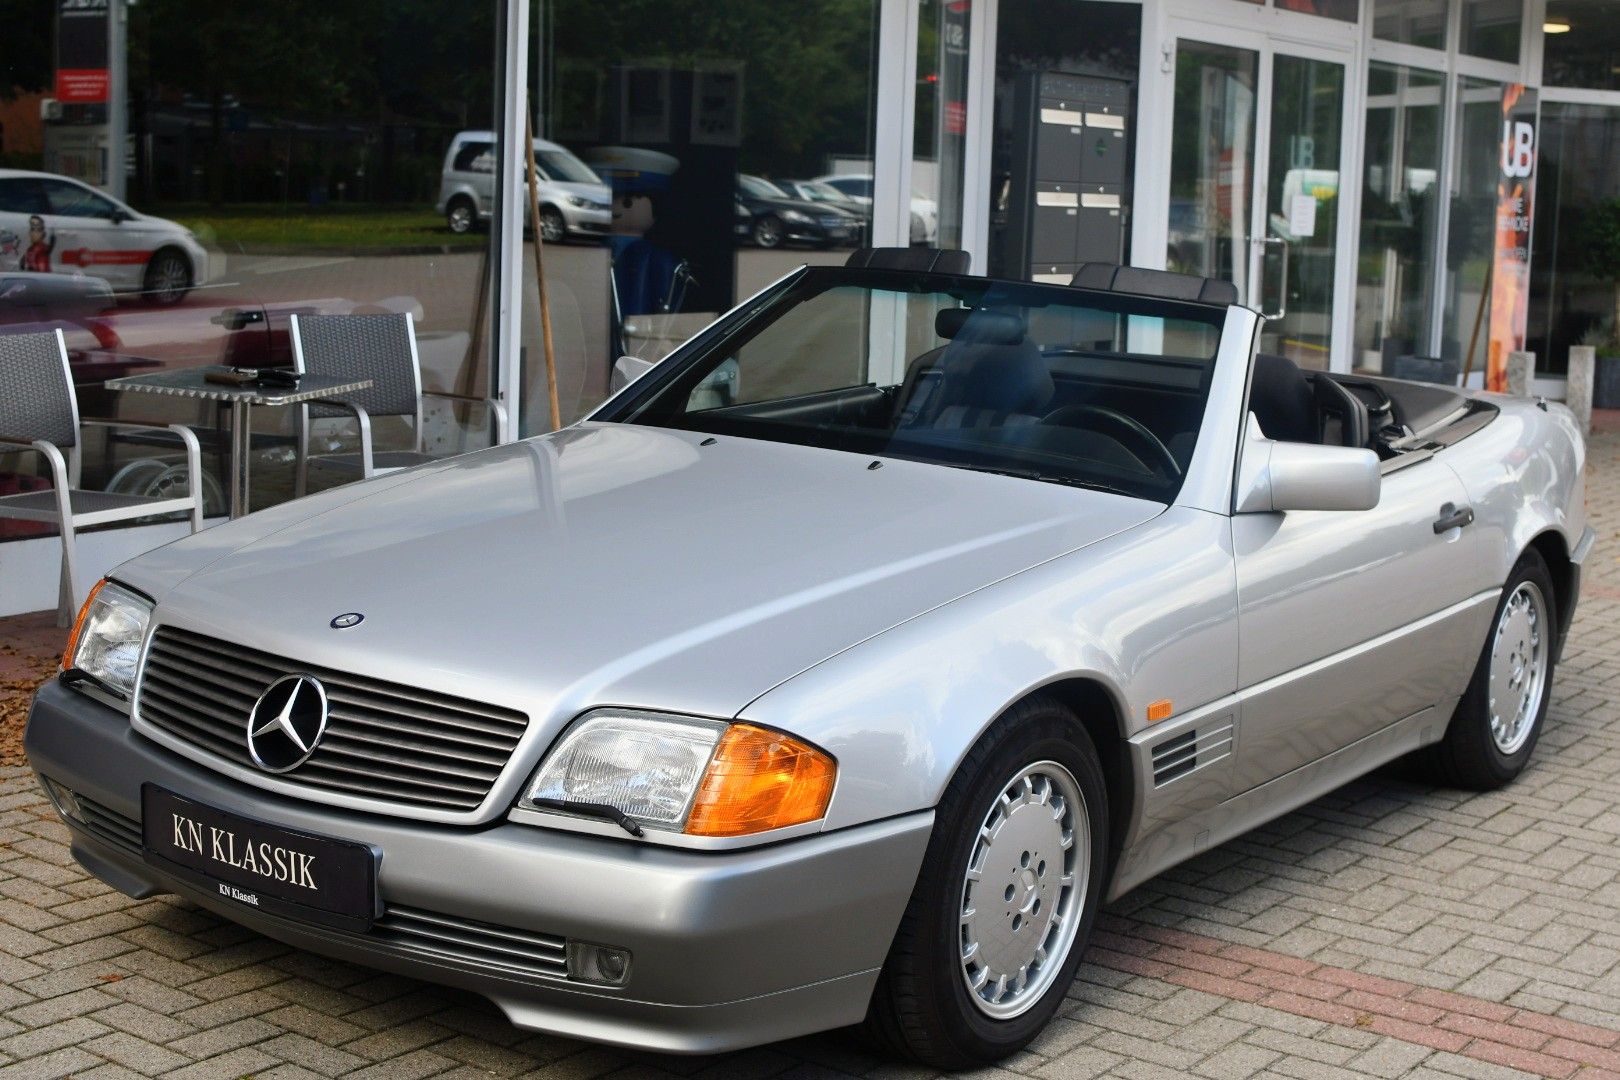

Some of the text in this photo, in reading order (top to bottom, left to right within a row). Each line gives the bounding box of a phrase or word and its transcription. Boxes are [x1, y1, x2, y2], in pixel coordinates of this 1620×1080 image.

[172, 813, 318, 890] KN KLASSIK
[219, 883, 259, 906] KN Klassik
